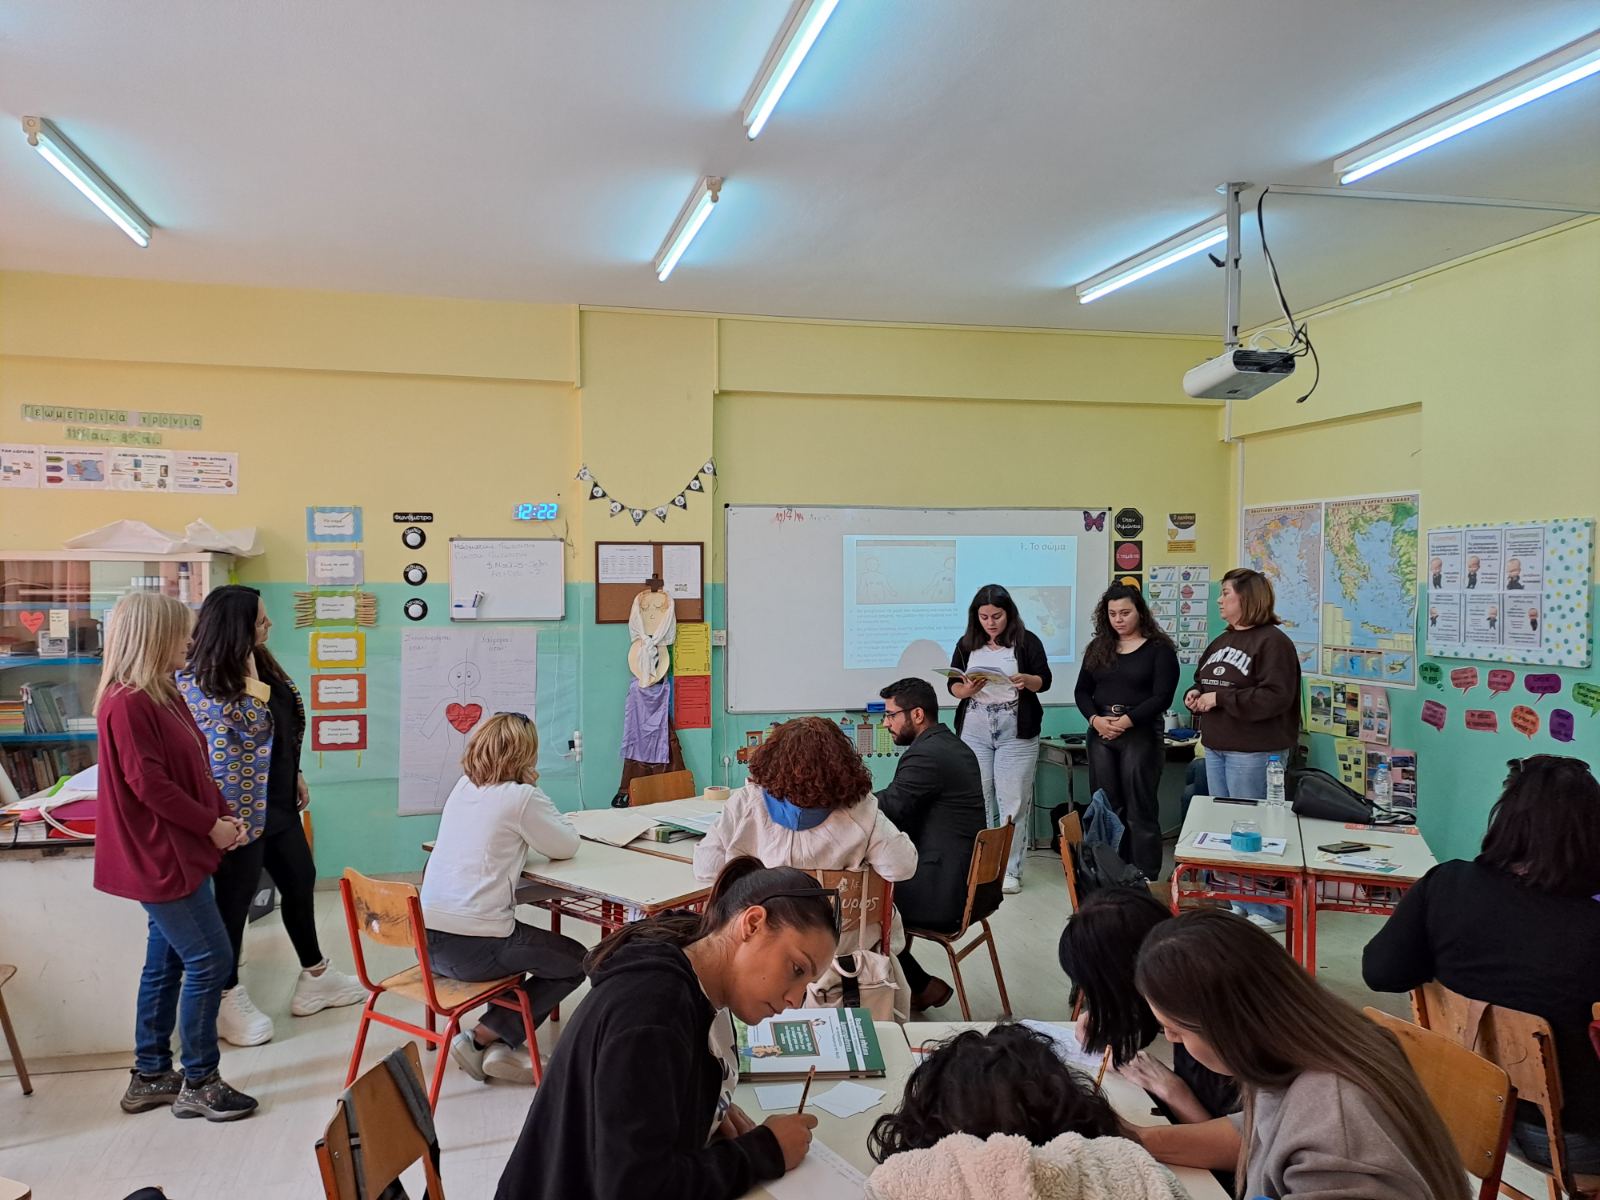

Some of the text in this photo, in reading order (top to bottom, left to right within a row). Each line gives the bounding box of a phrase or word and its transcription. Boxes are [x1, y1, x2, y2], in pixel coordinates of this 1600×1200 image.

[394, 513, 432, 521] Φωνόμετρο
[517, 503, 558, 520] 12:22
[1029, 542, 1040, 551] Το
[1041, 541, 1067, 552] σώμα
